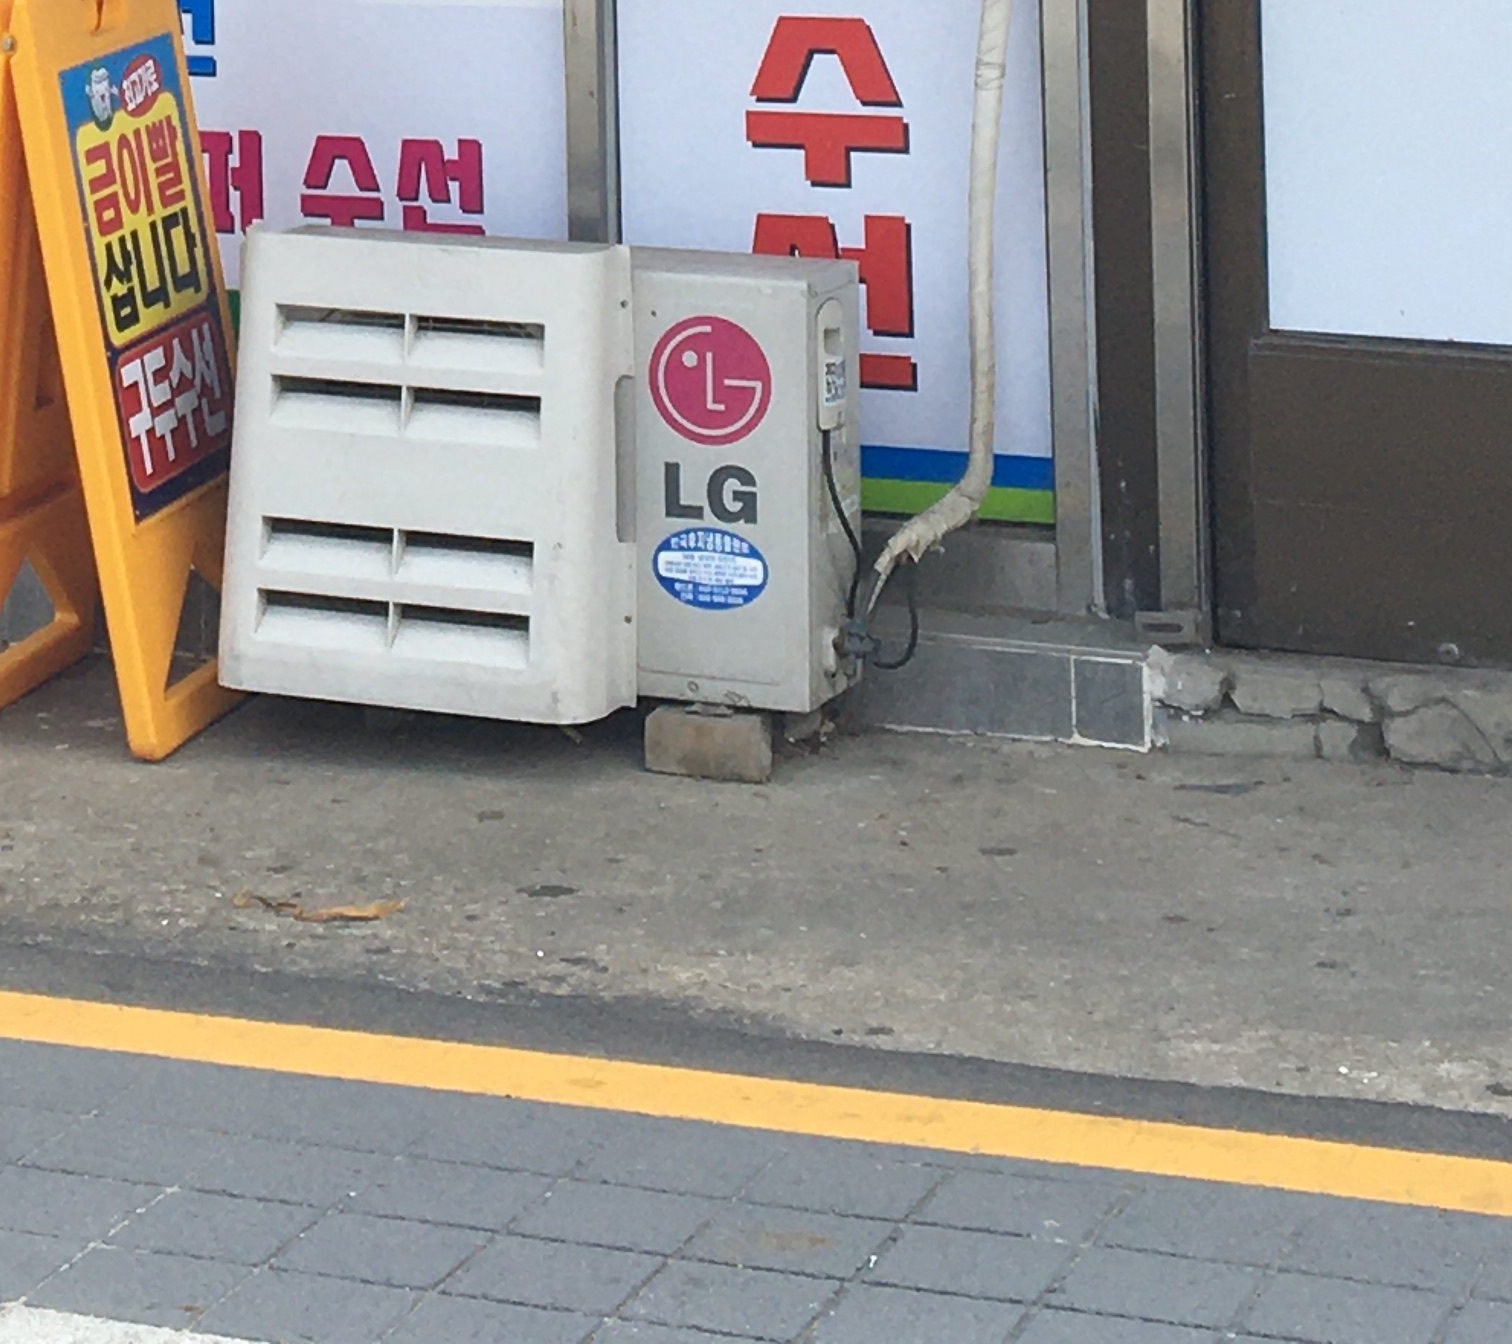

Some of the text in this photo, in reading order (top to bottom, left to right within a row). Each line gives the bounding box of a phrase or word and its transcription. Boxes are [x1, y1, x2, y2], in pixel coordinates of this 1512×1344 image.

[85, 115, 187, 238] 금이빨
[299, 134, 487, 236] 수선
[102, 207, 202, 334] 삽니다
[121, 321, 229, 479] 구두수선
[664, 461, 758, 524] LG
